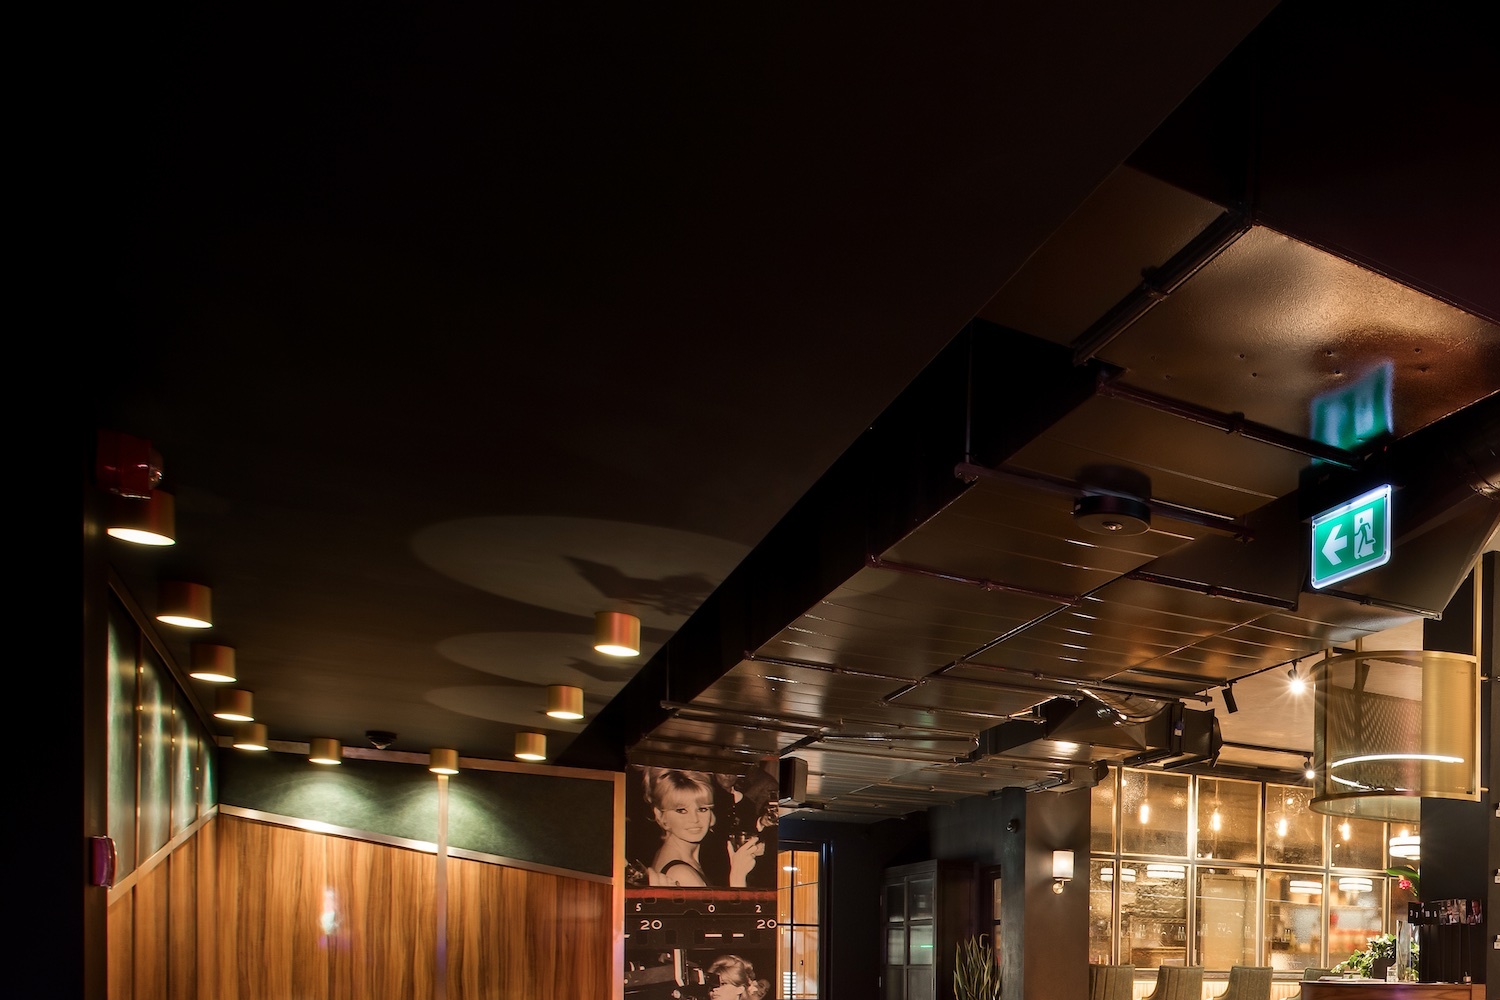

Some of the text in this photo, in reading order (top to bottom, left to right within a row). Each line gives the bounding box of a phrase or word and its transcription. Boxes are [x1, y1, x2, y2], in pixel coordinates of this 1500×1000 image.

[635, 903, 642, 912] 5
[755, 904, 762, 913] 2
[640, 919, 662, 930] 20
[756, 919, 777, 929] 20
